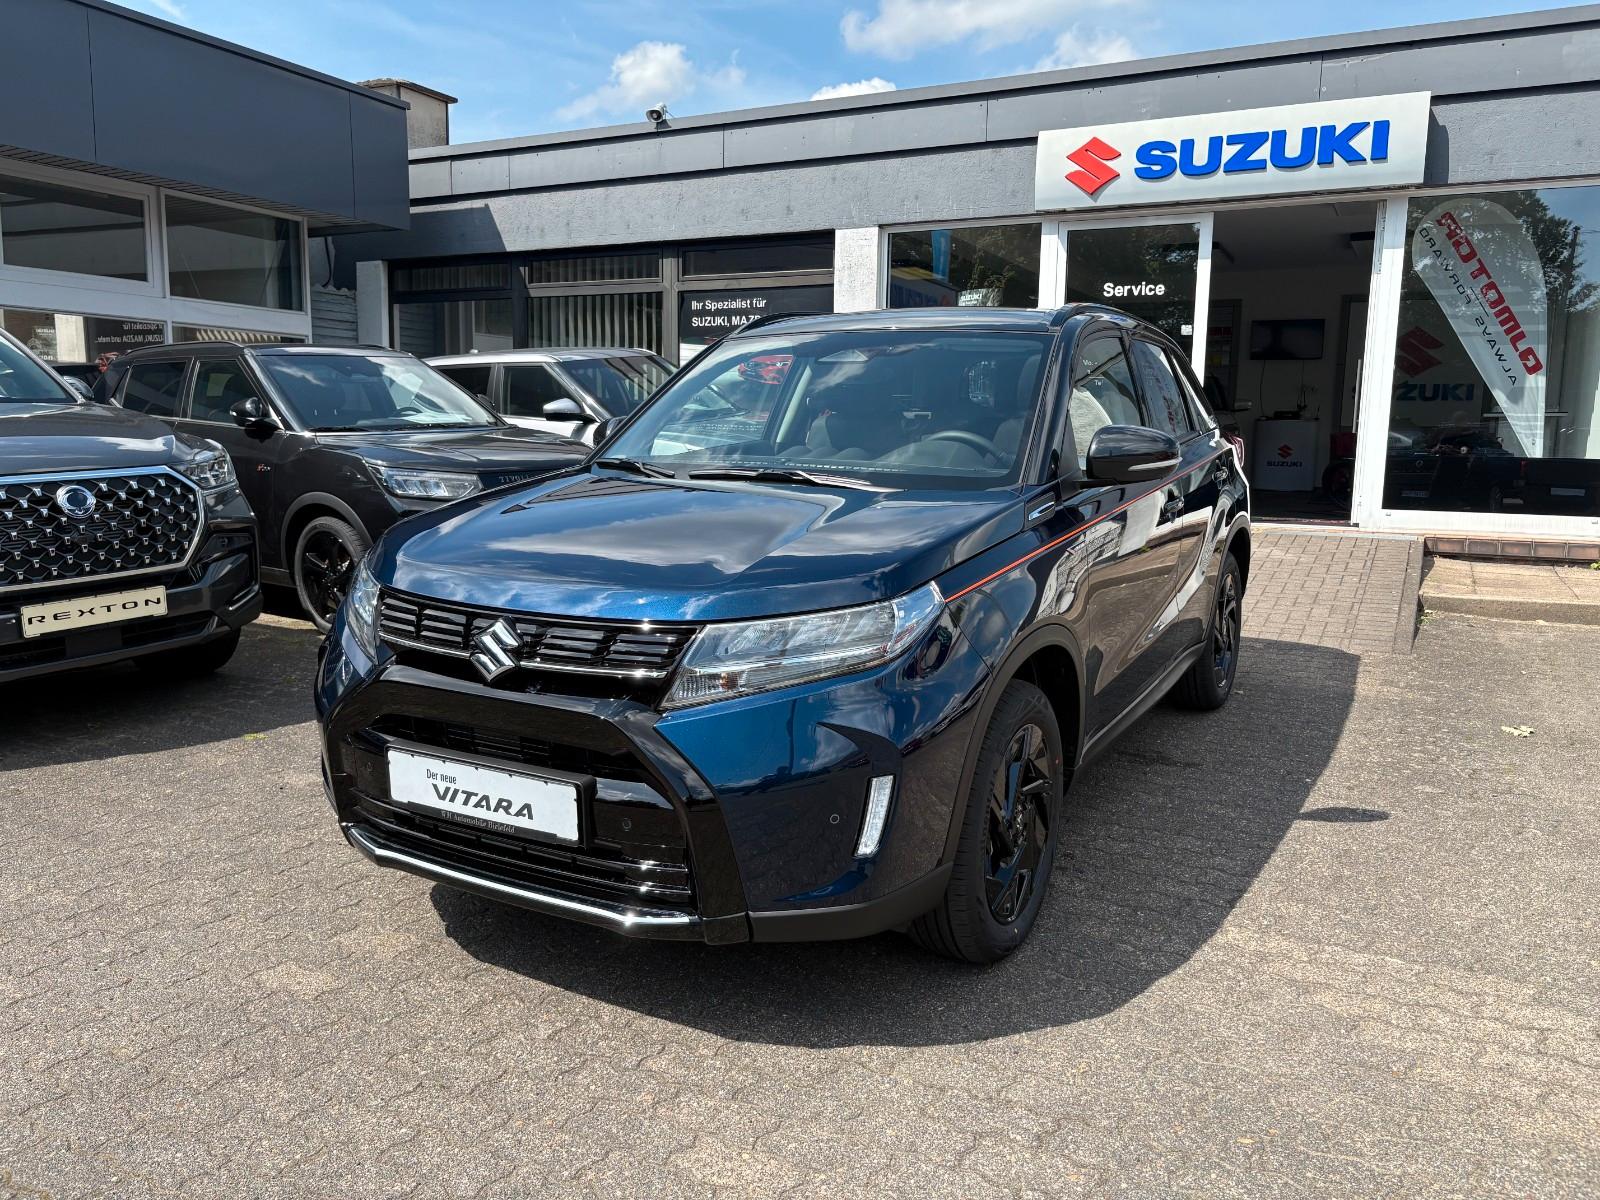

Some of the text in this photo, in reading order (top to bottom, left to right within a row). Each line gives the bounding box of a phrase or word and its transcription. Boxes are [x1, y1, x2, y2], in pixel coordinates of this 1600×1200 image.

[1134, 120, 1390, 179] SUZUKI
[1103, 282, 1165, 297] Service
[691, 298, 767, 311] Ihr Spezialist für
[691, 316, 730, 327] SUZUKI,
[28, 597, 160, 625] REXTON
[426, 768, 457, 785] Der neue
[431, 783, 534, 820] VITARA
